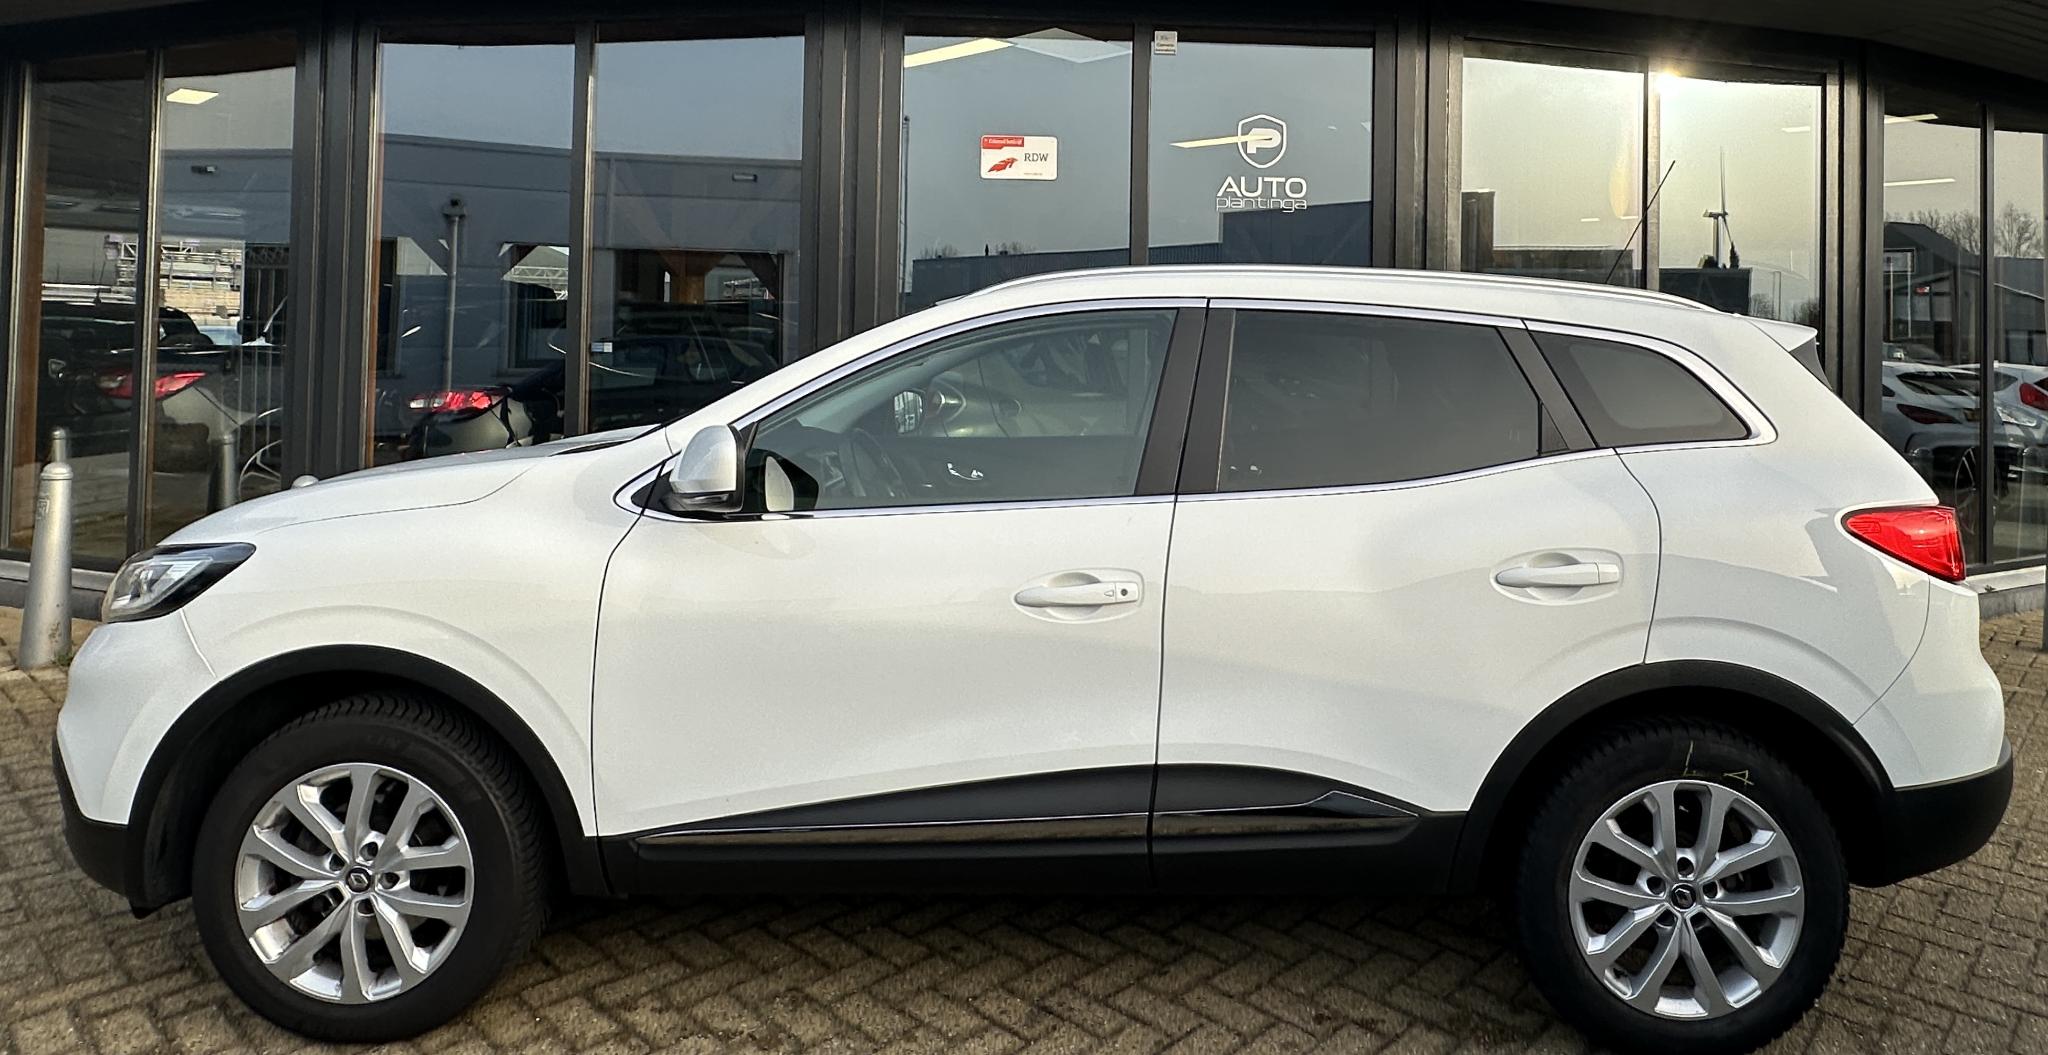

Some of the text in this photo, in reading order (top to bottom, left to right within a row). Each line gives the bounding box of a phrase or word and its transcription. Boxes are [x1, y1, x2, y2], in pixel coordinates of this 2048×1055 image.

[1023, 152, 1049, 162] RDW
[1216, 175, 1307, 199] AUTO
[1216, 196, 1307, 213] plantinga
